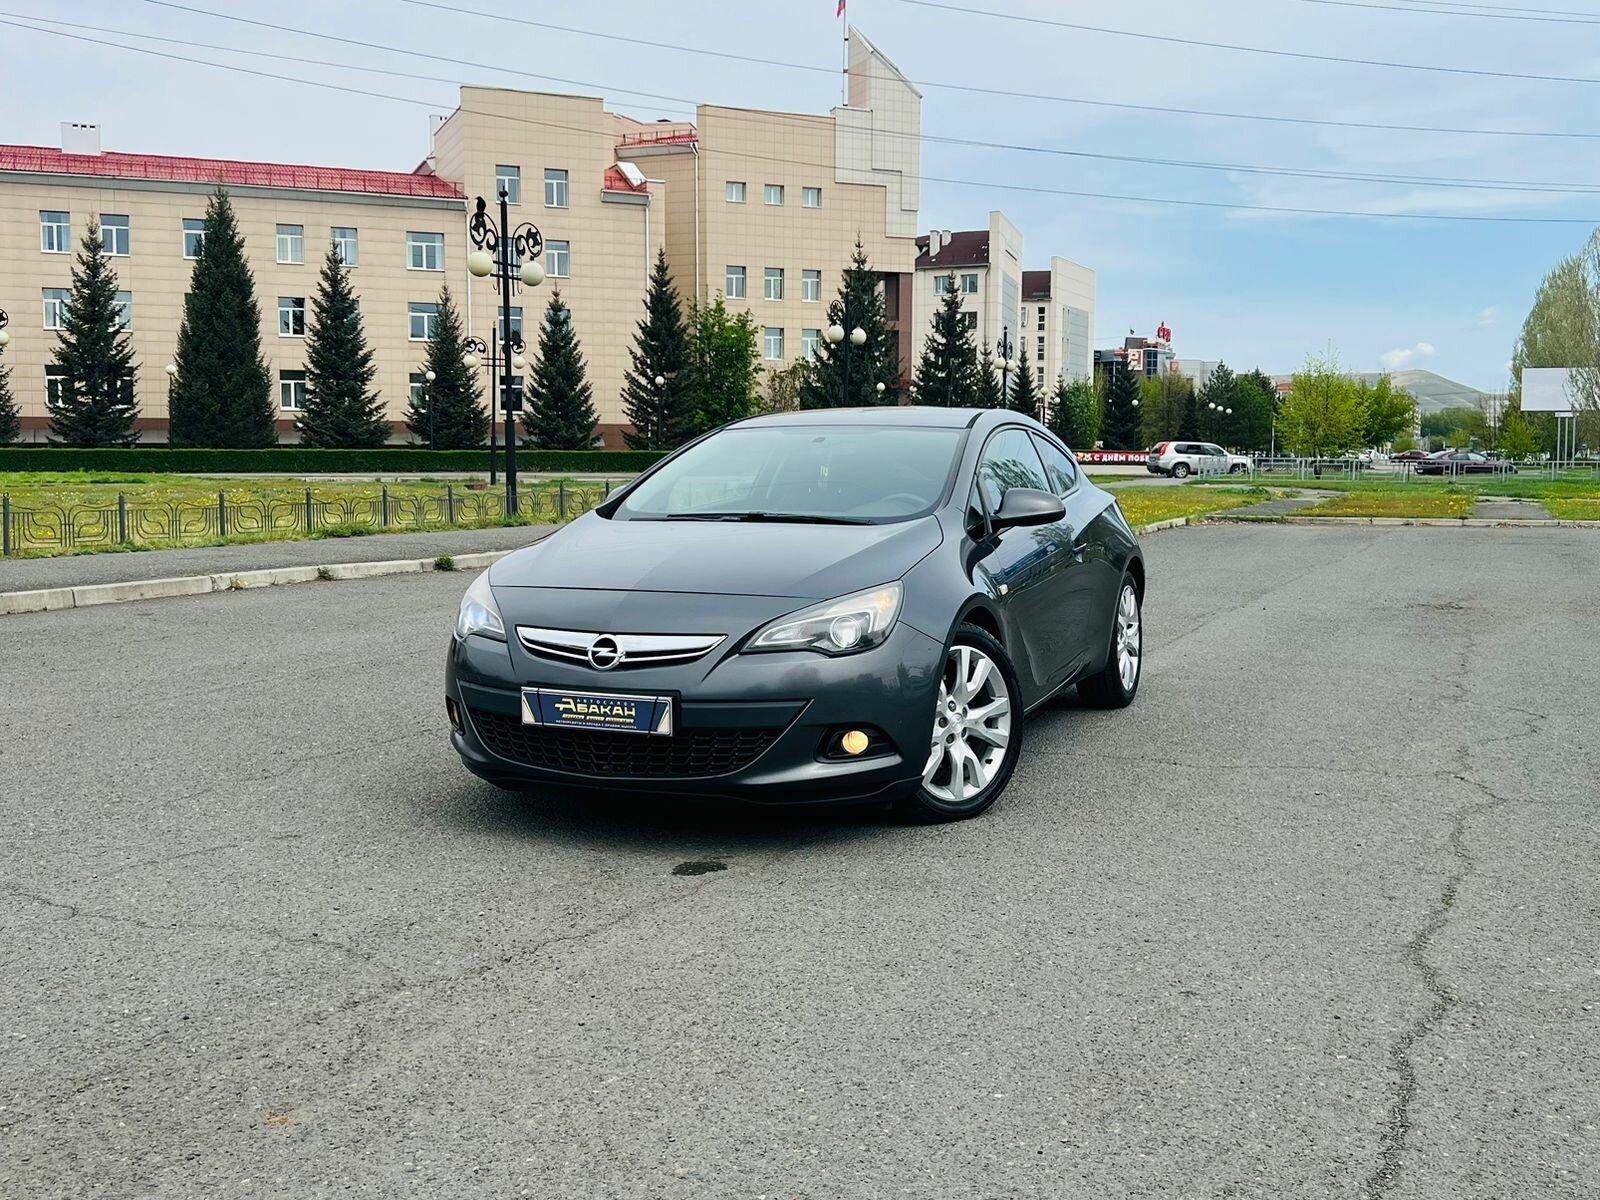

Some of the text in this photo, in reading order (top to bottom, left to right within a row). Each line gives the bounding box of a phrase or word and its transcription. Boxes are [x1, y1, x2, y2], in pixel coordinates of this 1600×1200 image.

[1128, 454, 1150, 462] ПОБЕ
[576, 698, 635, 707] АВТОСАЛОН
[554, 698, 636, 717] АБАКАН
